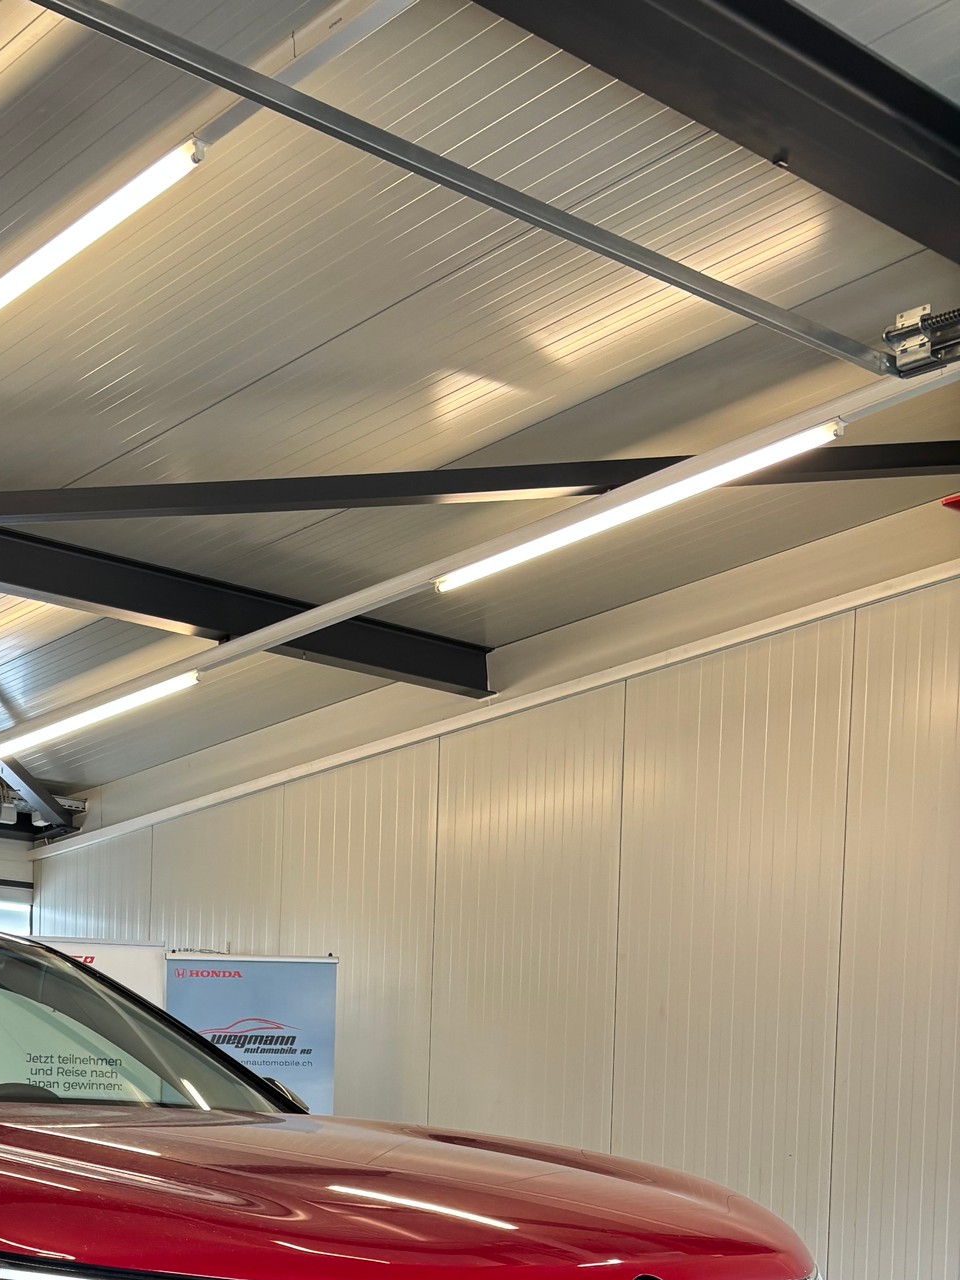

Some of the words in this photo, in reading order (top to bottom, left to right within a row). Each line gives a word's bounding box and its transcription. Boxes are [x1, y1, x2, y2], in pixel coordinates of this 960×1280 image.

[189, 969, 242, 978] HONDA
[210, 1033, 297, 1049] wegmann
[26, 1053, 55, 1064] Jetzt
[57, 1054, 123, 1066] teilnehmen
[30, 1067, 53, 1076] und
[57, 1067, 87, 1077] Reise
[90, 1069, 118, 1079] nach
[63, 1080, 123, 1092] gewinnen:
